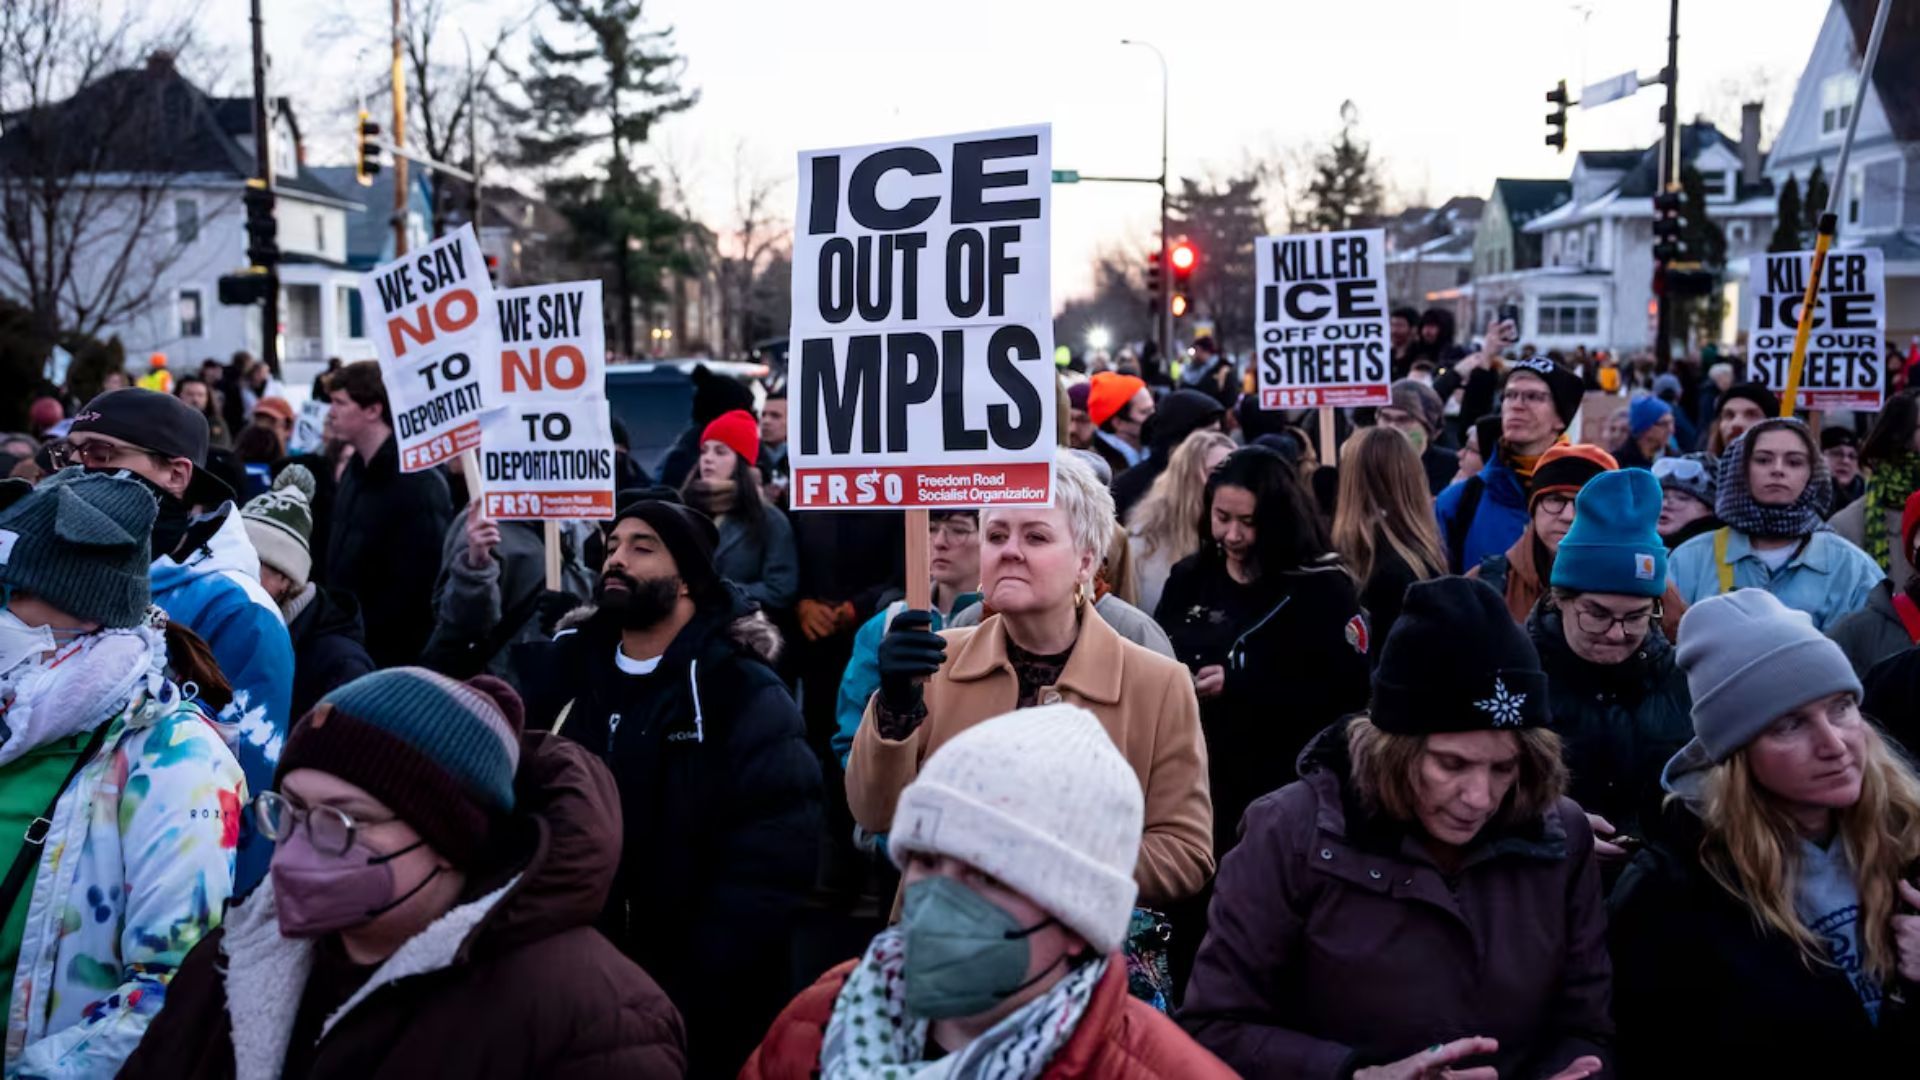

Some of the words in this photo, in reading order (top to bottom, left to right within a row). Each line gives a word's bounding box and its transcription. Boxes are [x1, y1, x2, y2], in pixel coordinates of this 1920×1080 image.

[808, 135, 1041, 235] ICE
[376, 262, 417, 313] WE
[417, 238, 467, 293] SAY
[818, 231, 927, 323] OUT
[946, 224, 1021, 319] OF
[1272, 237, 1368, 282] KILLER
[497, 296, 532, 343] WE
[538, 291, 584, 340] SAY
[1264, 280, 1382, 322] ICE
[1758, 294, 1877, 329] ICE
[387, 288, 479, 358] NO
[1263, 325, 1317, 343] OFF
[1323, 323, 1383, 340] OUR
[1756, 335, 1800, 348] OF
[1816, 335, 1876, 348] OUR
[418, 352, 471, 391] TO
[501, 345, 587, 393] NO
[1263, 342, 1384, 386] STREETS
[800, 325, 1043, 456] MPLS
[522, 412, 572, 441] TO
[486, 448, 611, 481] DEPORTATIONS
[488, 493, 540, 514] FRSO
[802, 471, 903, 504] FRSO
[917, 474, 972, 487] Freedom
[974, 473, 1005, 486] Road
[918, 488, 967, 502] Socialist
[969, 487, 1045, 503] Organization
